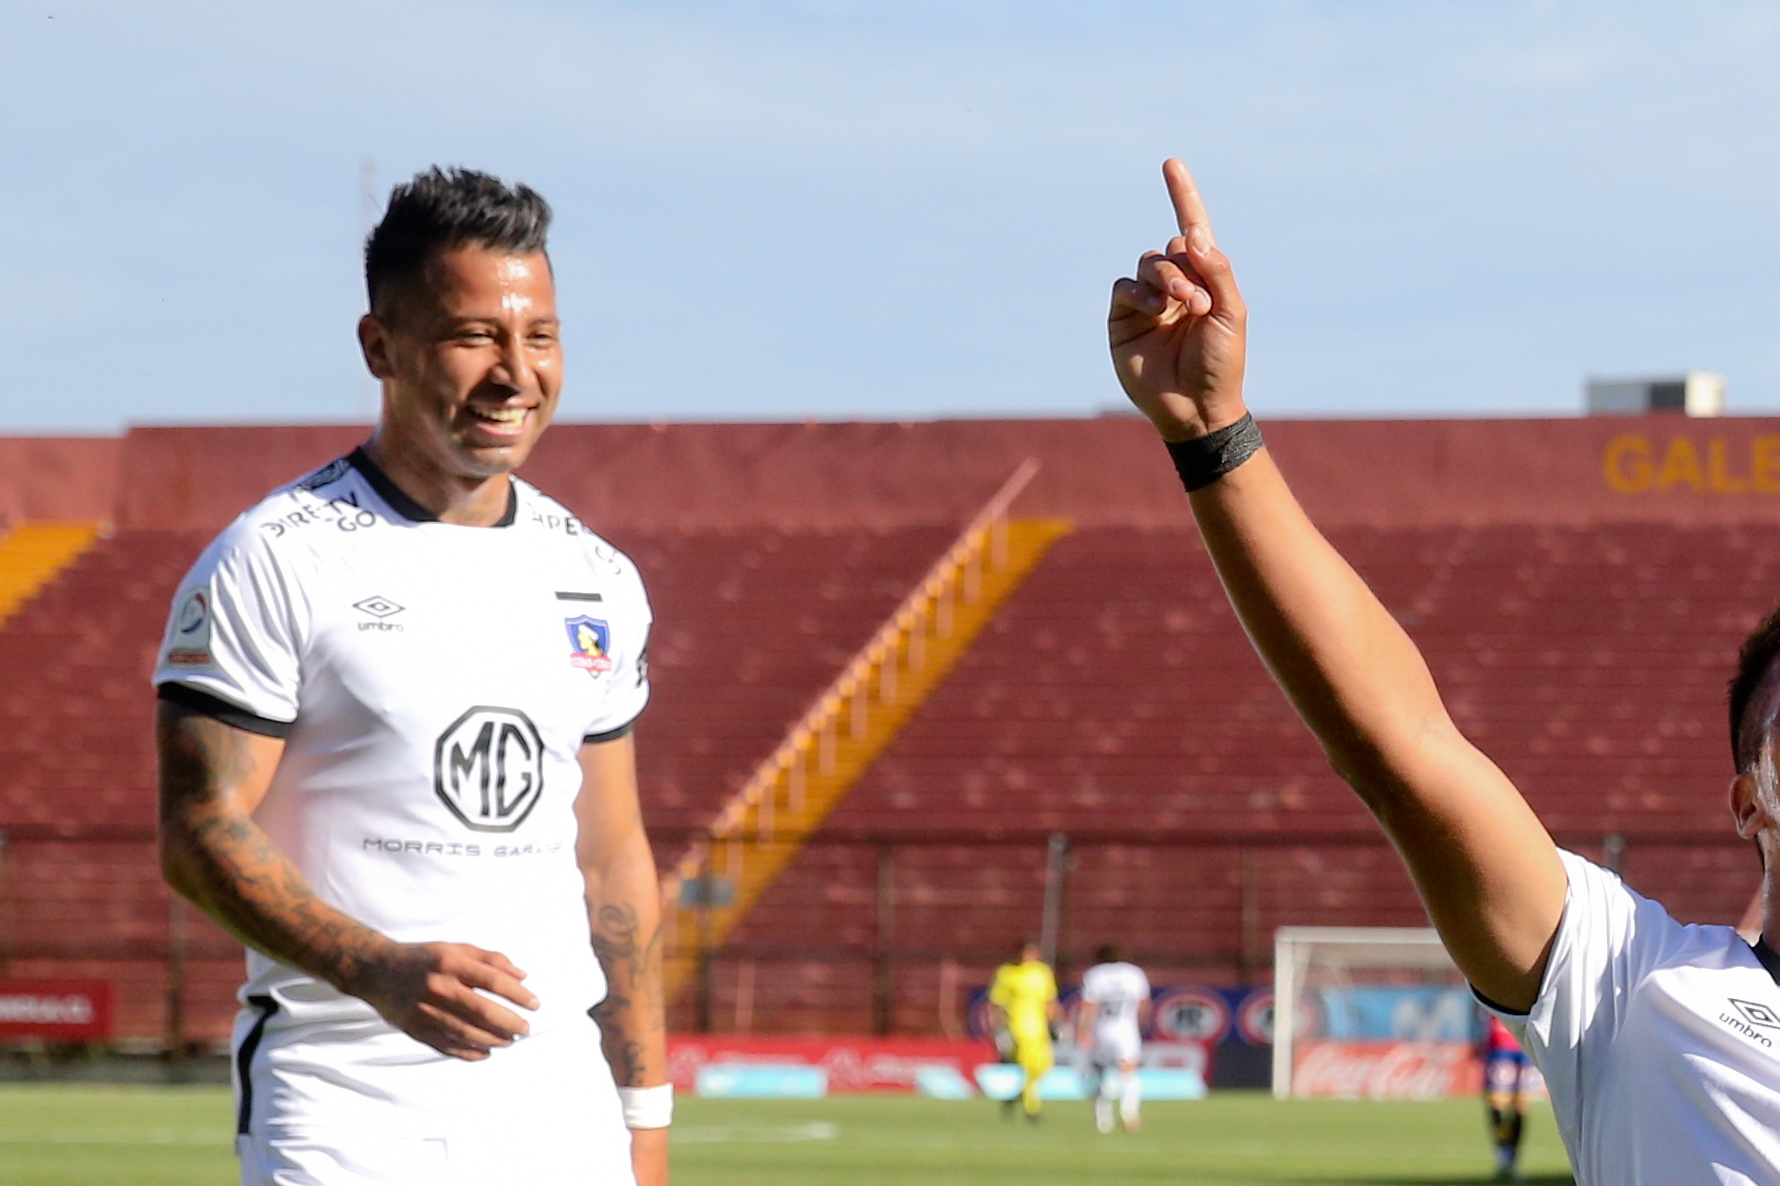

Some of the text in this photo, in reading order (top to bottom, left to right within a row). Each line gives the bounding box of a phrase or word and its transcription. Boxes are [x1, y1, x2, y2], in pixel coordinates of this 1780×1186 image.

[337, 509, 377, 532] GO
[357, 620, 404, 632] umbro
[450, 720, 533, 819] MG
[362, 837, 482, 858] MORRIS
[1717, 1011, 1774, 1049] umbro
